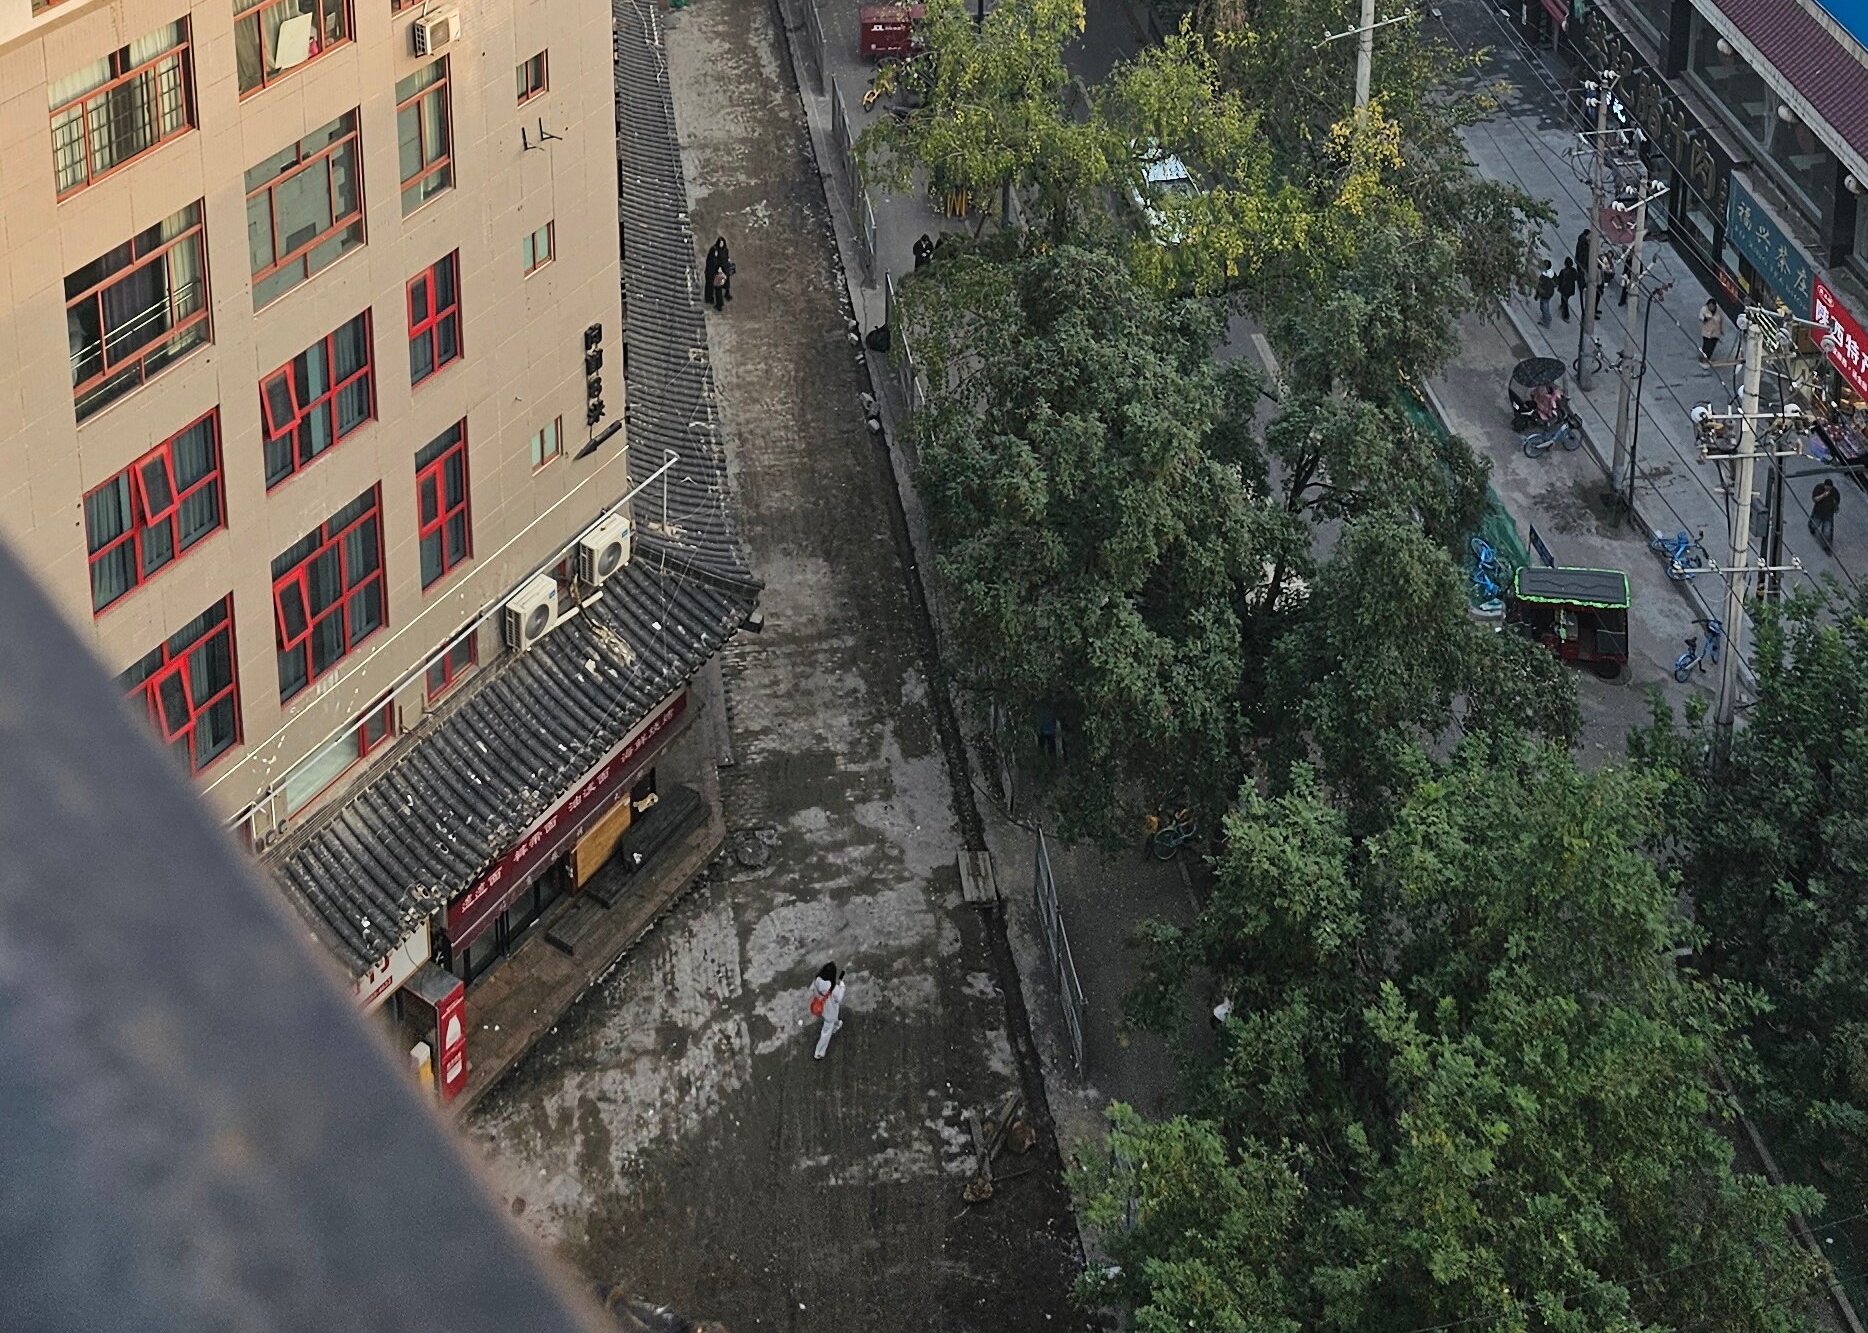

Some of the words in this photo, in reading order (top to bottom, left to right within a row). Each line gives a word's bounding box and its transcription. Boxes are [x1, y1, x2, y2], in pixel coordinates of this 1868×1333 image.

[1738, 200, 1808, 298] 福兴茶庄
[568, 767, 610, 812] 油泼面
